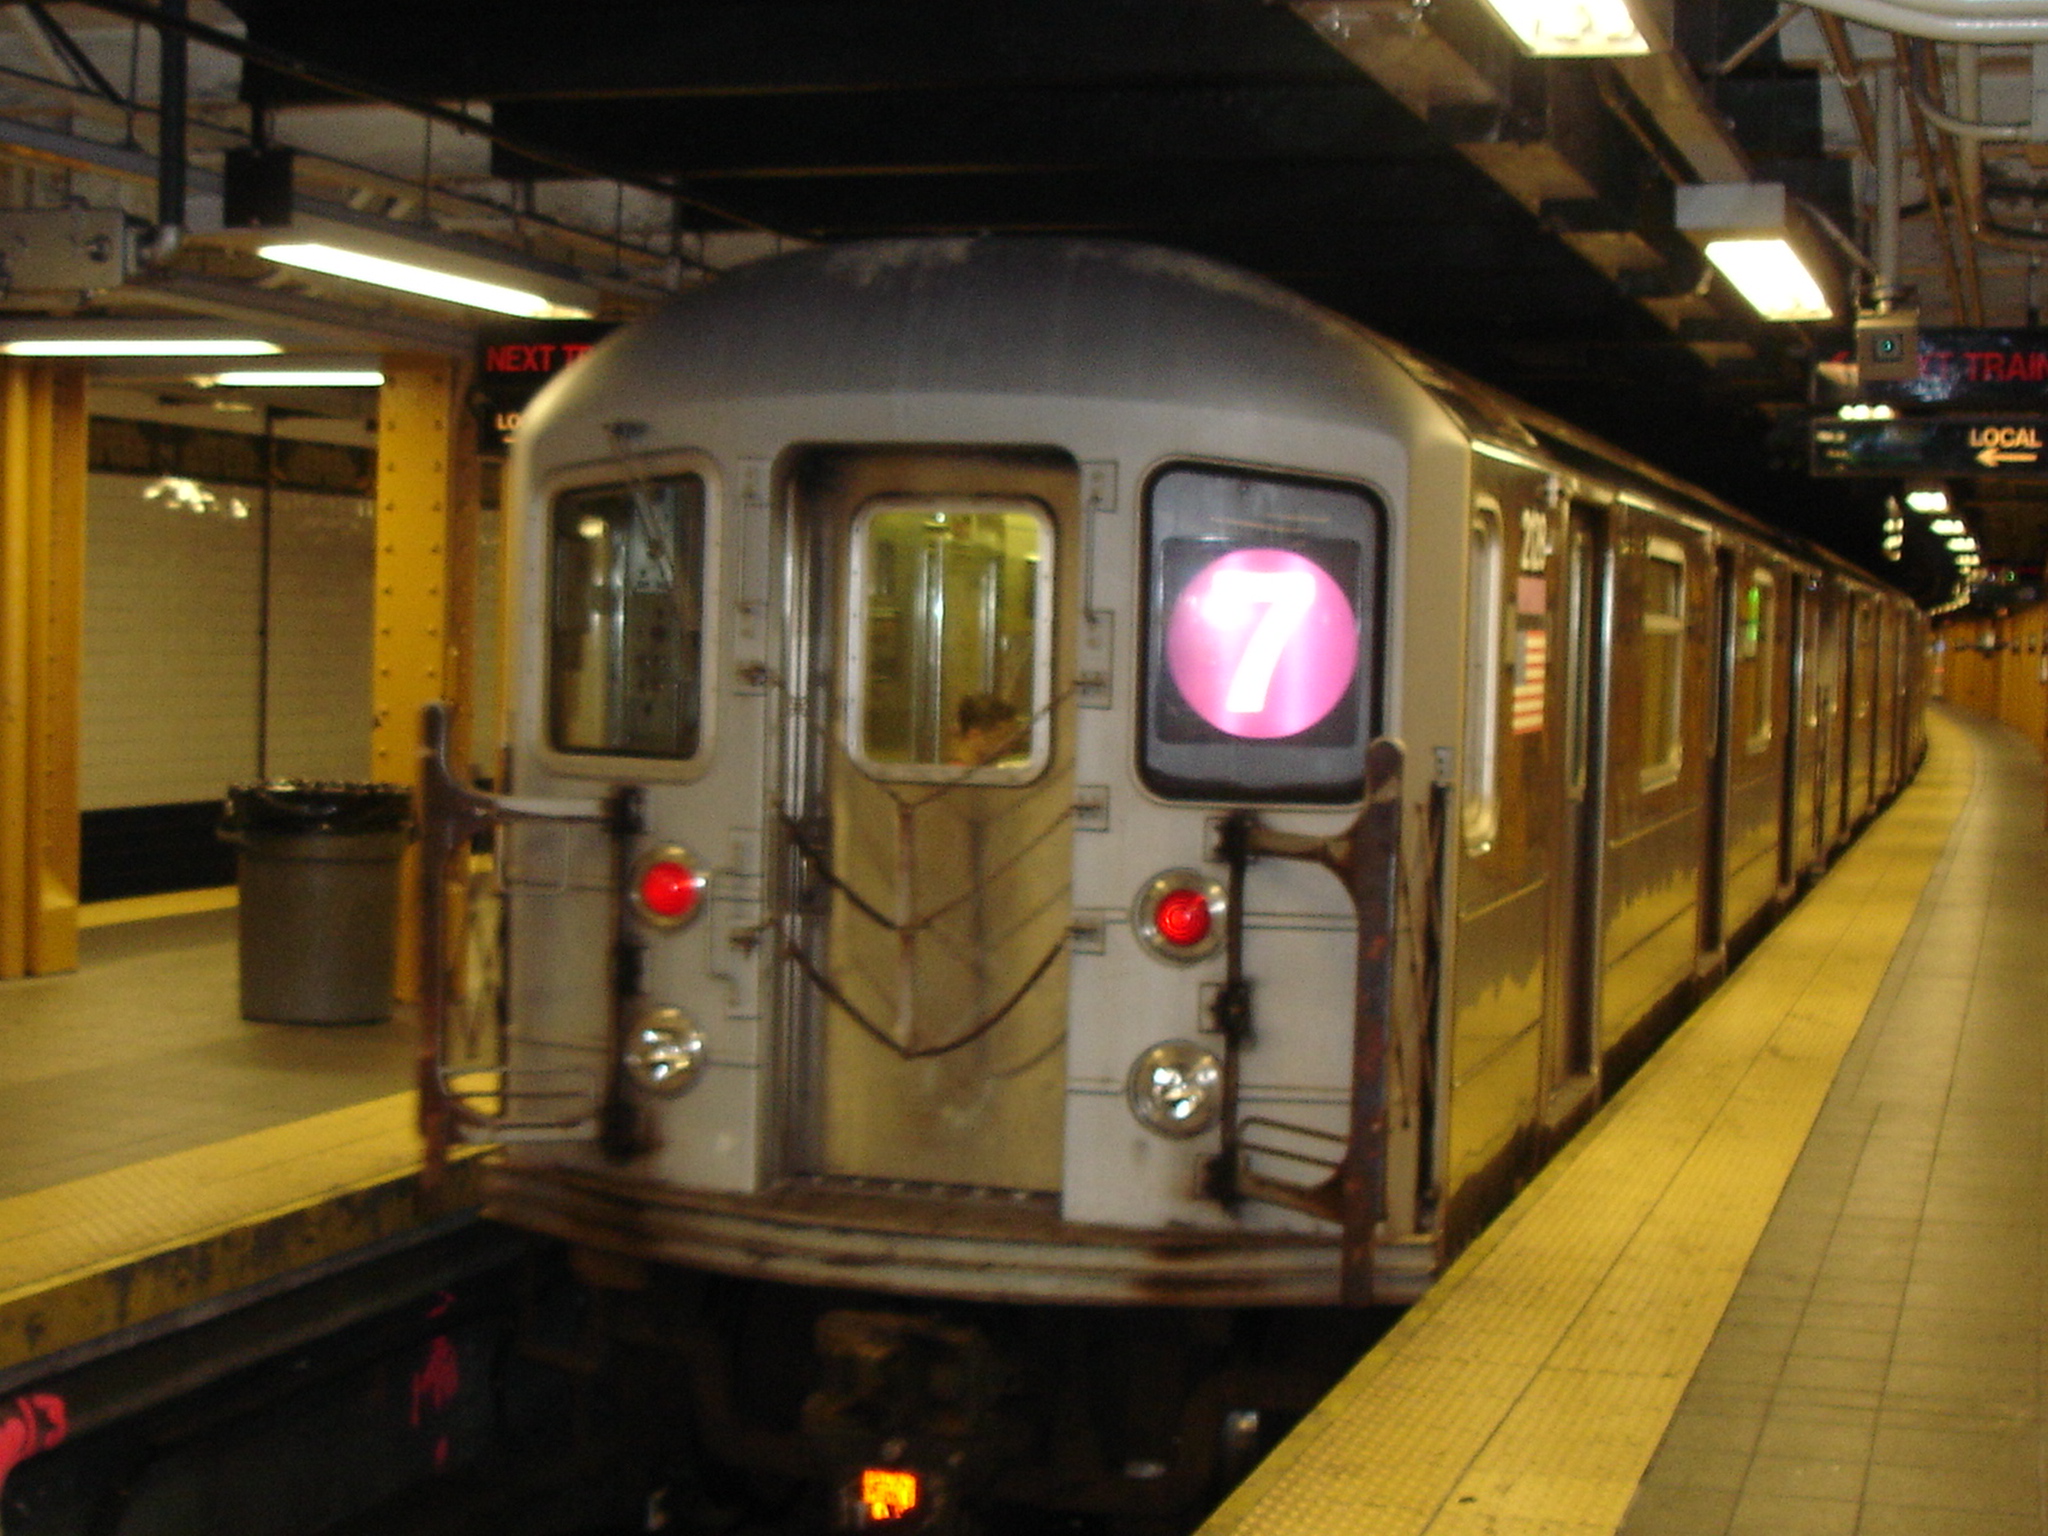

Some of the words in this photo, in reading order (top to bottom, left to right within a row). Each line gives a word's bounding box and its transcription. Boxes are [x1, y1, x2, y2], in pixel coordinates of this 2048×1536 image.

[485, 344, 556, 372] NEXT
[1962, 351, 2048, 382] TRAIN
[1968, 426, 2044, 449] LOCAL
[1202, 569, 1317, 714] 7
